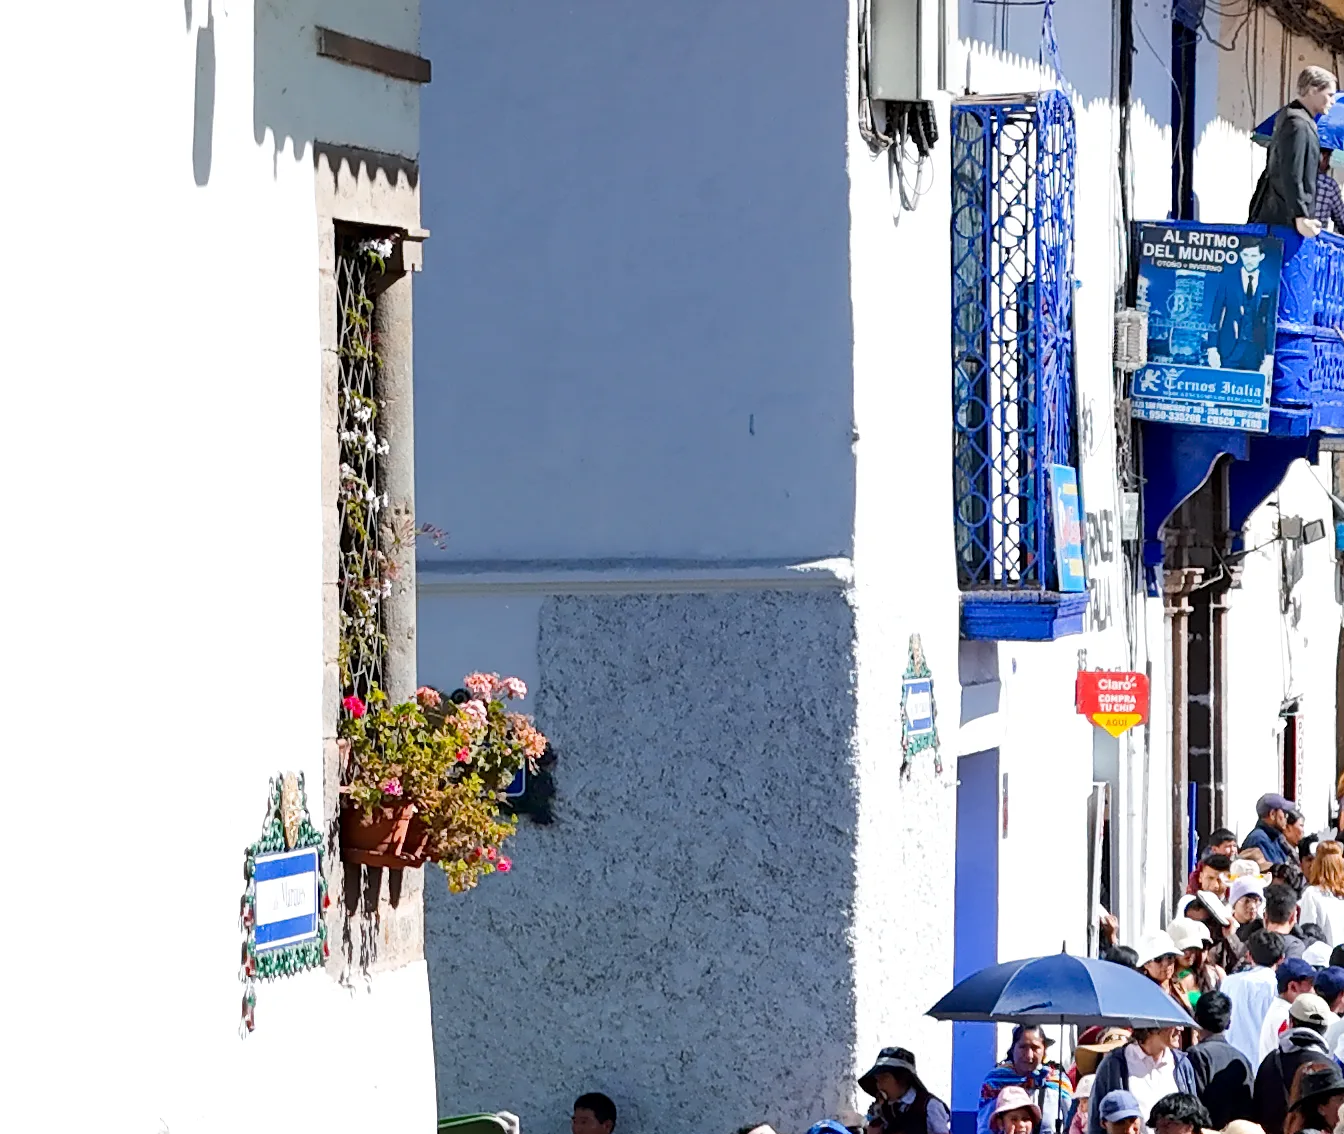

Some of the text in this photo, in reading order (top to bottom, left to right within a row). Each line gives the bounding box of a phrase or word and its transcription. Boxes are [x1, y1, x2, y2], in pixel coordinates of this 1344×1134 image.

[1163, 230, 1240, 249] AL RITMO
[1143, 243, 1239, 264] DEL MUNDO
[1098, 678, 1134, 691] Claro
[1098, 693, 1137, 703] COMPRA
[1101, 703, 1136, 713] TU CHIP
